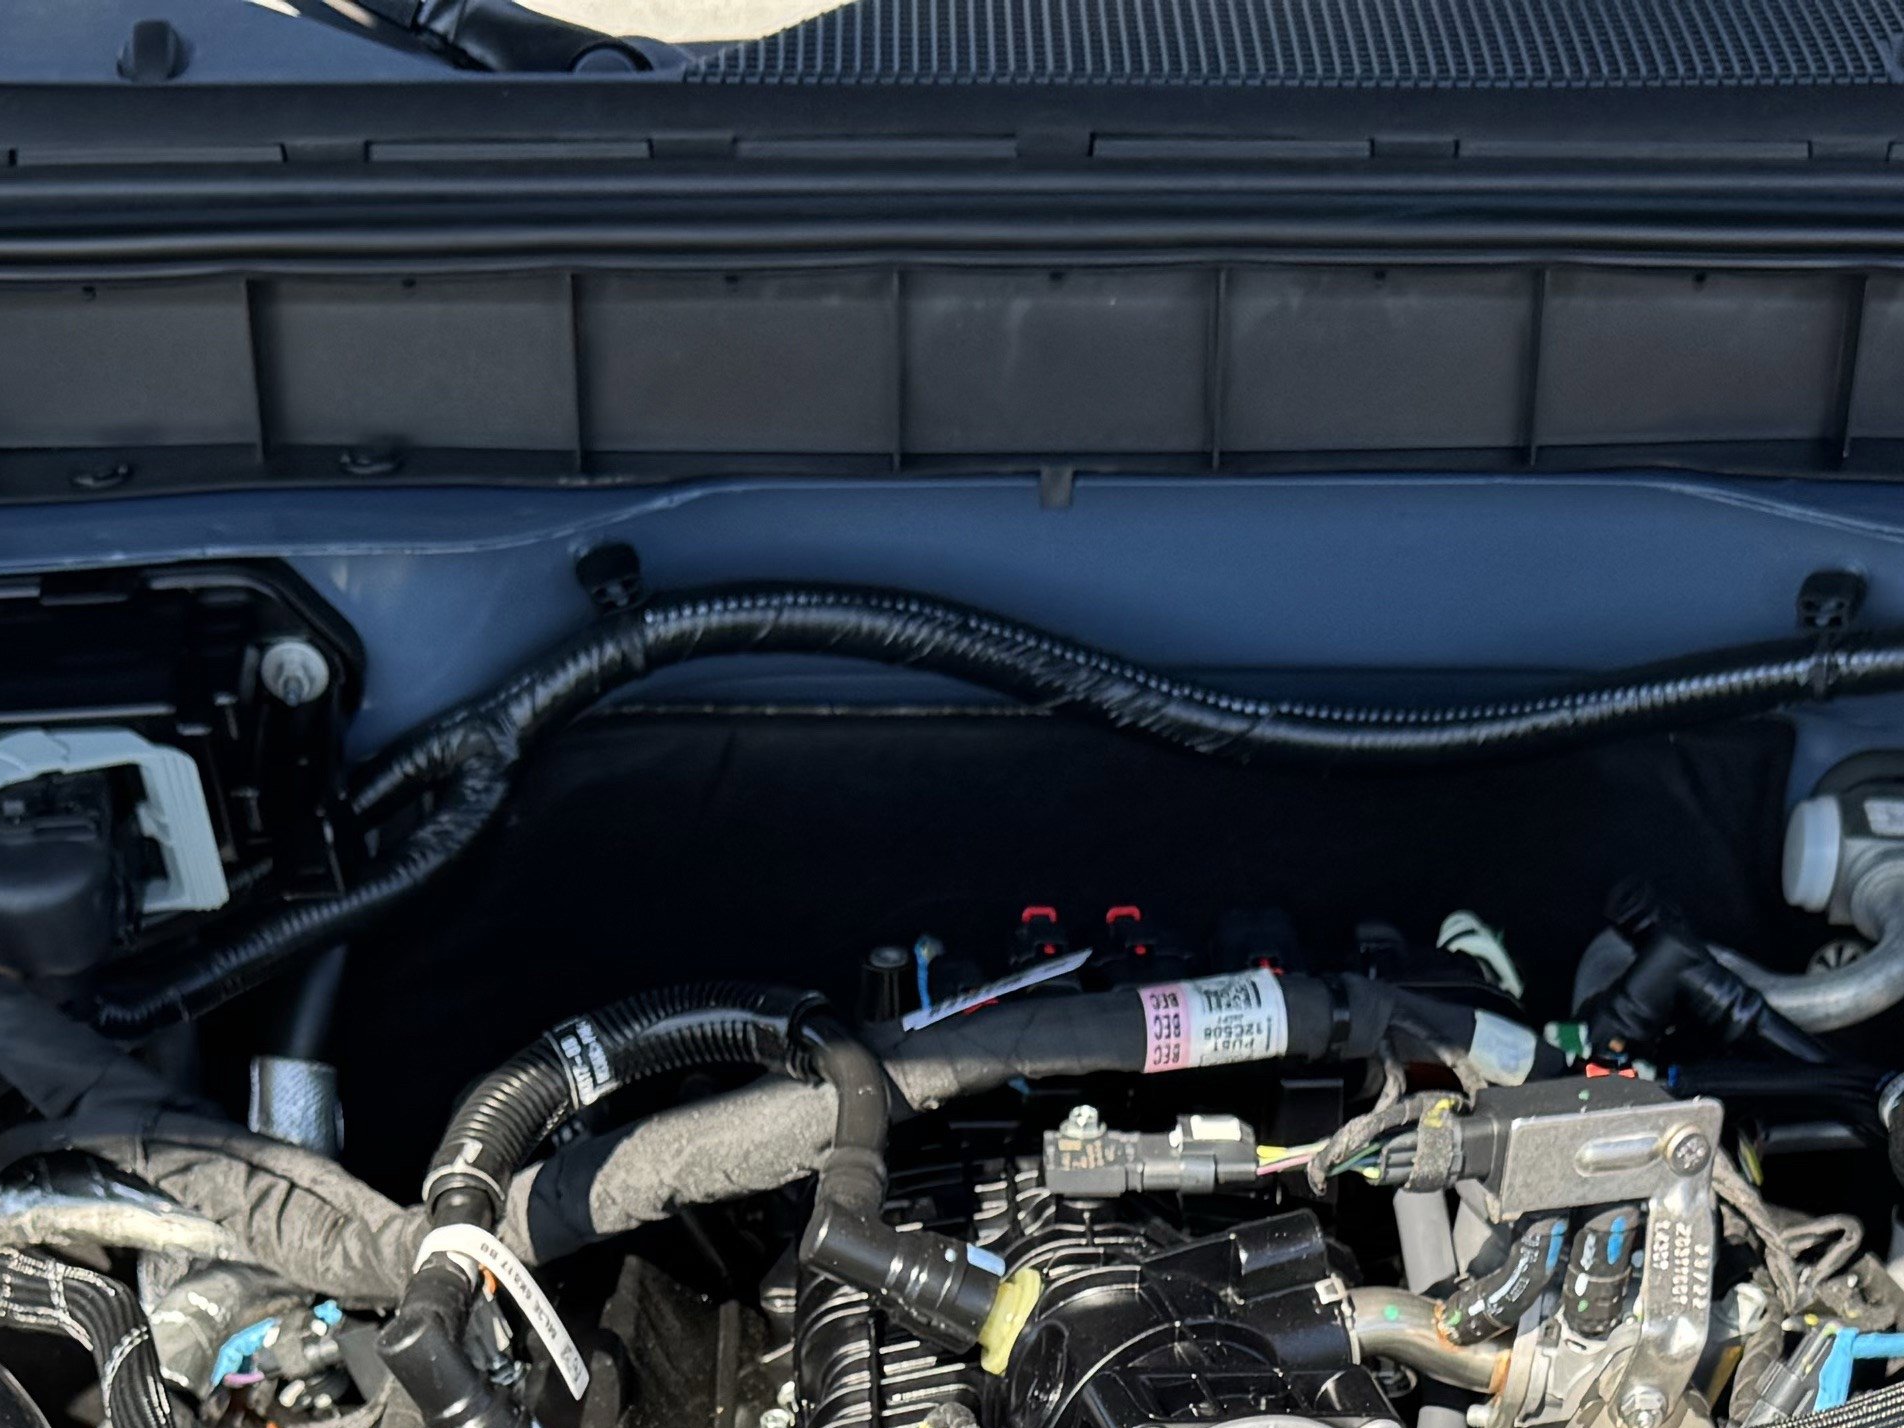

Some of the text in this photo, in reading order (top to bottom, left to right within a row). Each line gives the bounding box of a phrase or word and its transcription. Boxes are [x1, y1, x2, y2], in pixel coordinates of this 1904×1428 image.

[1149, 992, 1180, 1010] BEC
[1154, 1013, 1181, 1041] BEC
[1153, 1043, 1181, 1066] BEC
